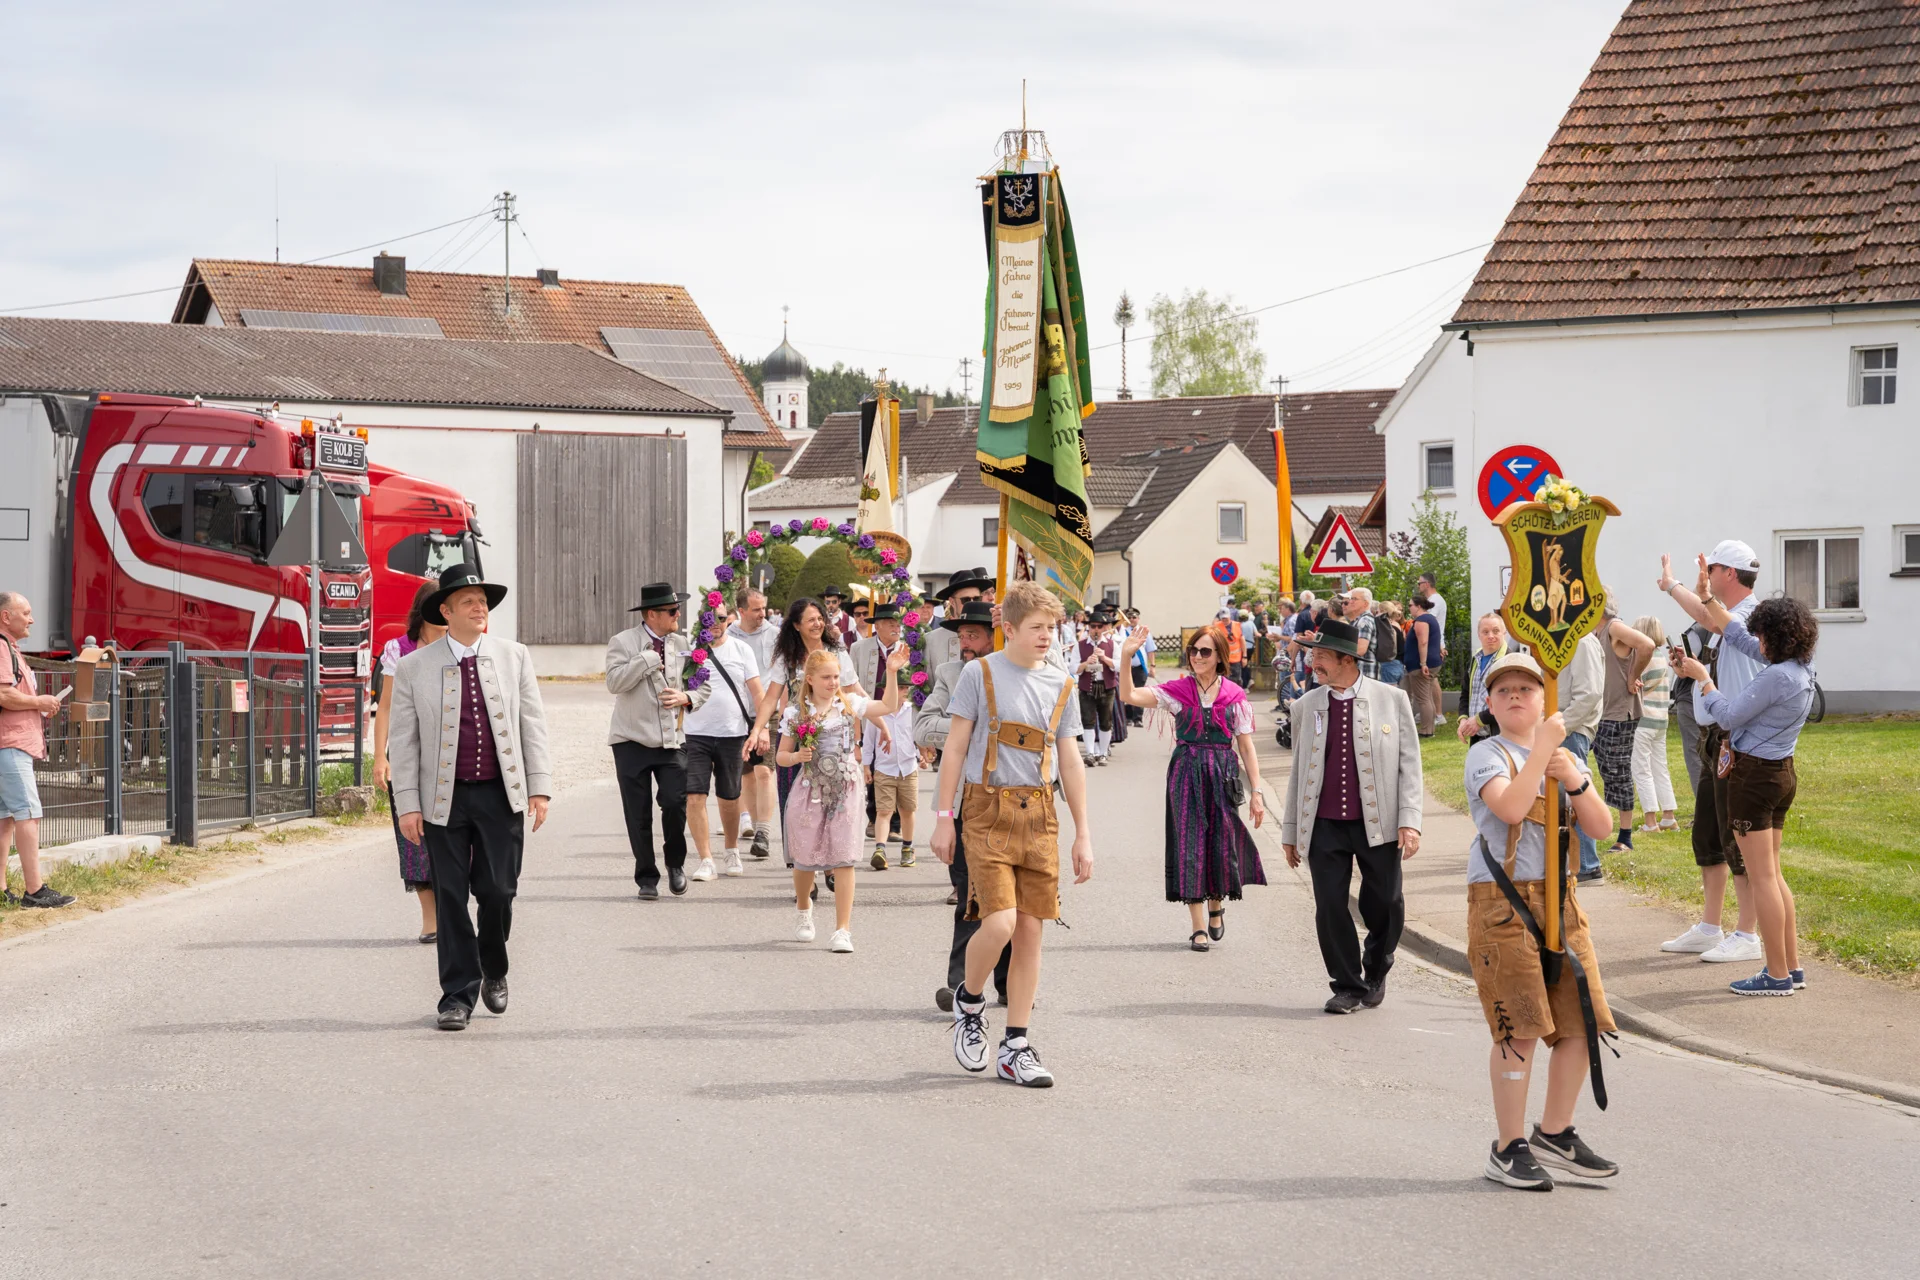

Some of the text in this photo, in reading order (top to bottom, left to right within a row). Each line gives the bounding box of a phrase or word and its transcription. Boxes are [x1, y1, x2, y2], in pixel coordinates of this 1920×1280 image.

[1001, 255, 1034, 270] Meiner
[1011, 290, 1024, 299] die
[333, 441, 353, 457] KOLB
[330, 584, 356, 598] SCANIA
[1509, 592, 1604, 619] 19 19
[359, 653, 367, 673] A
